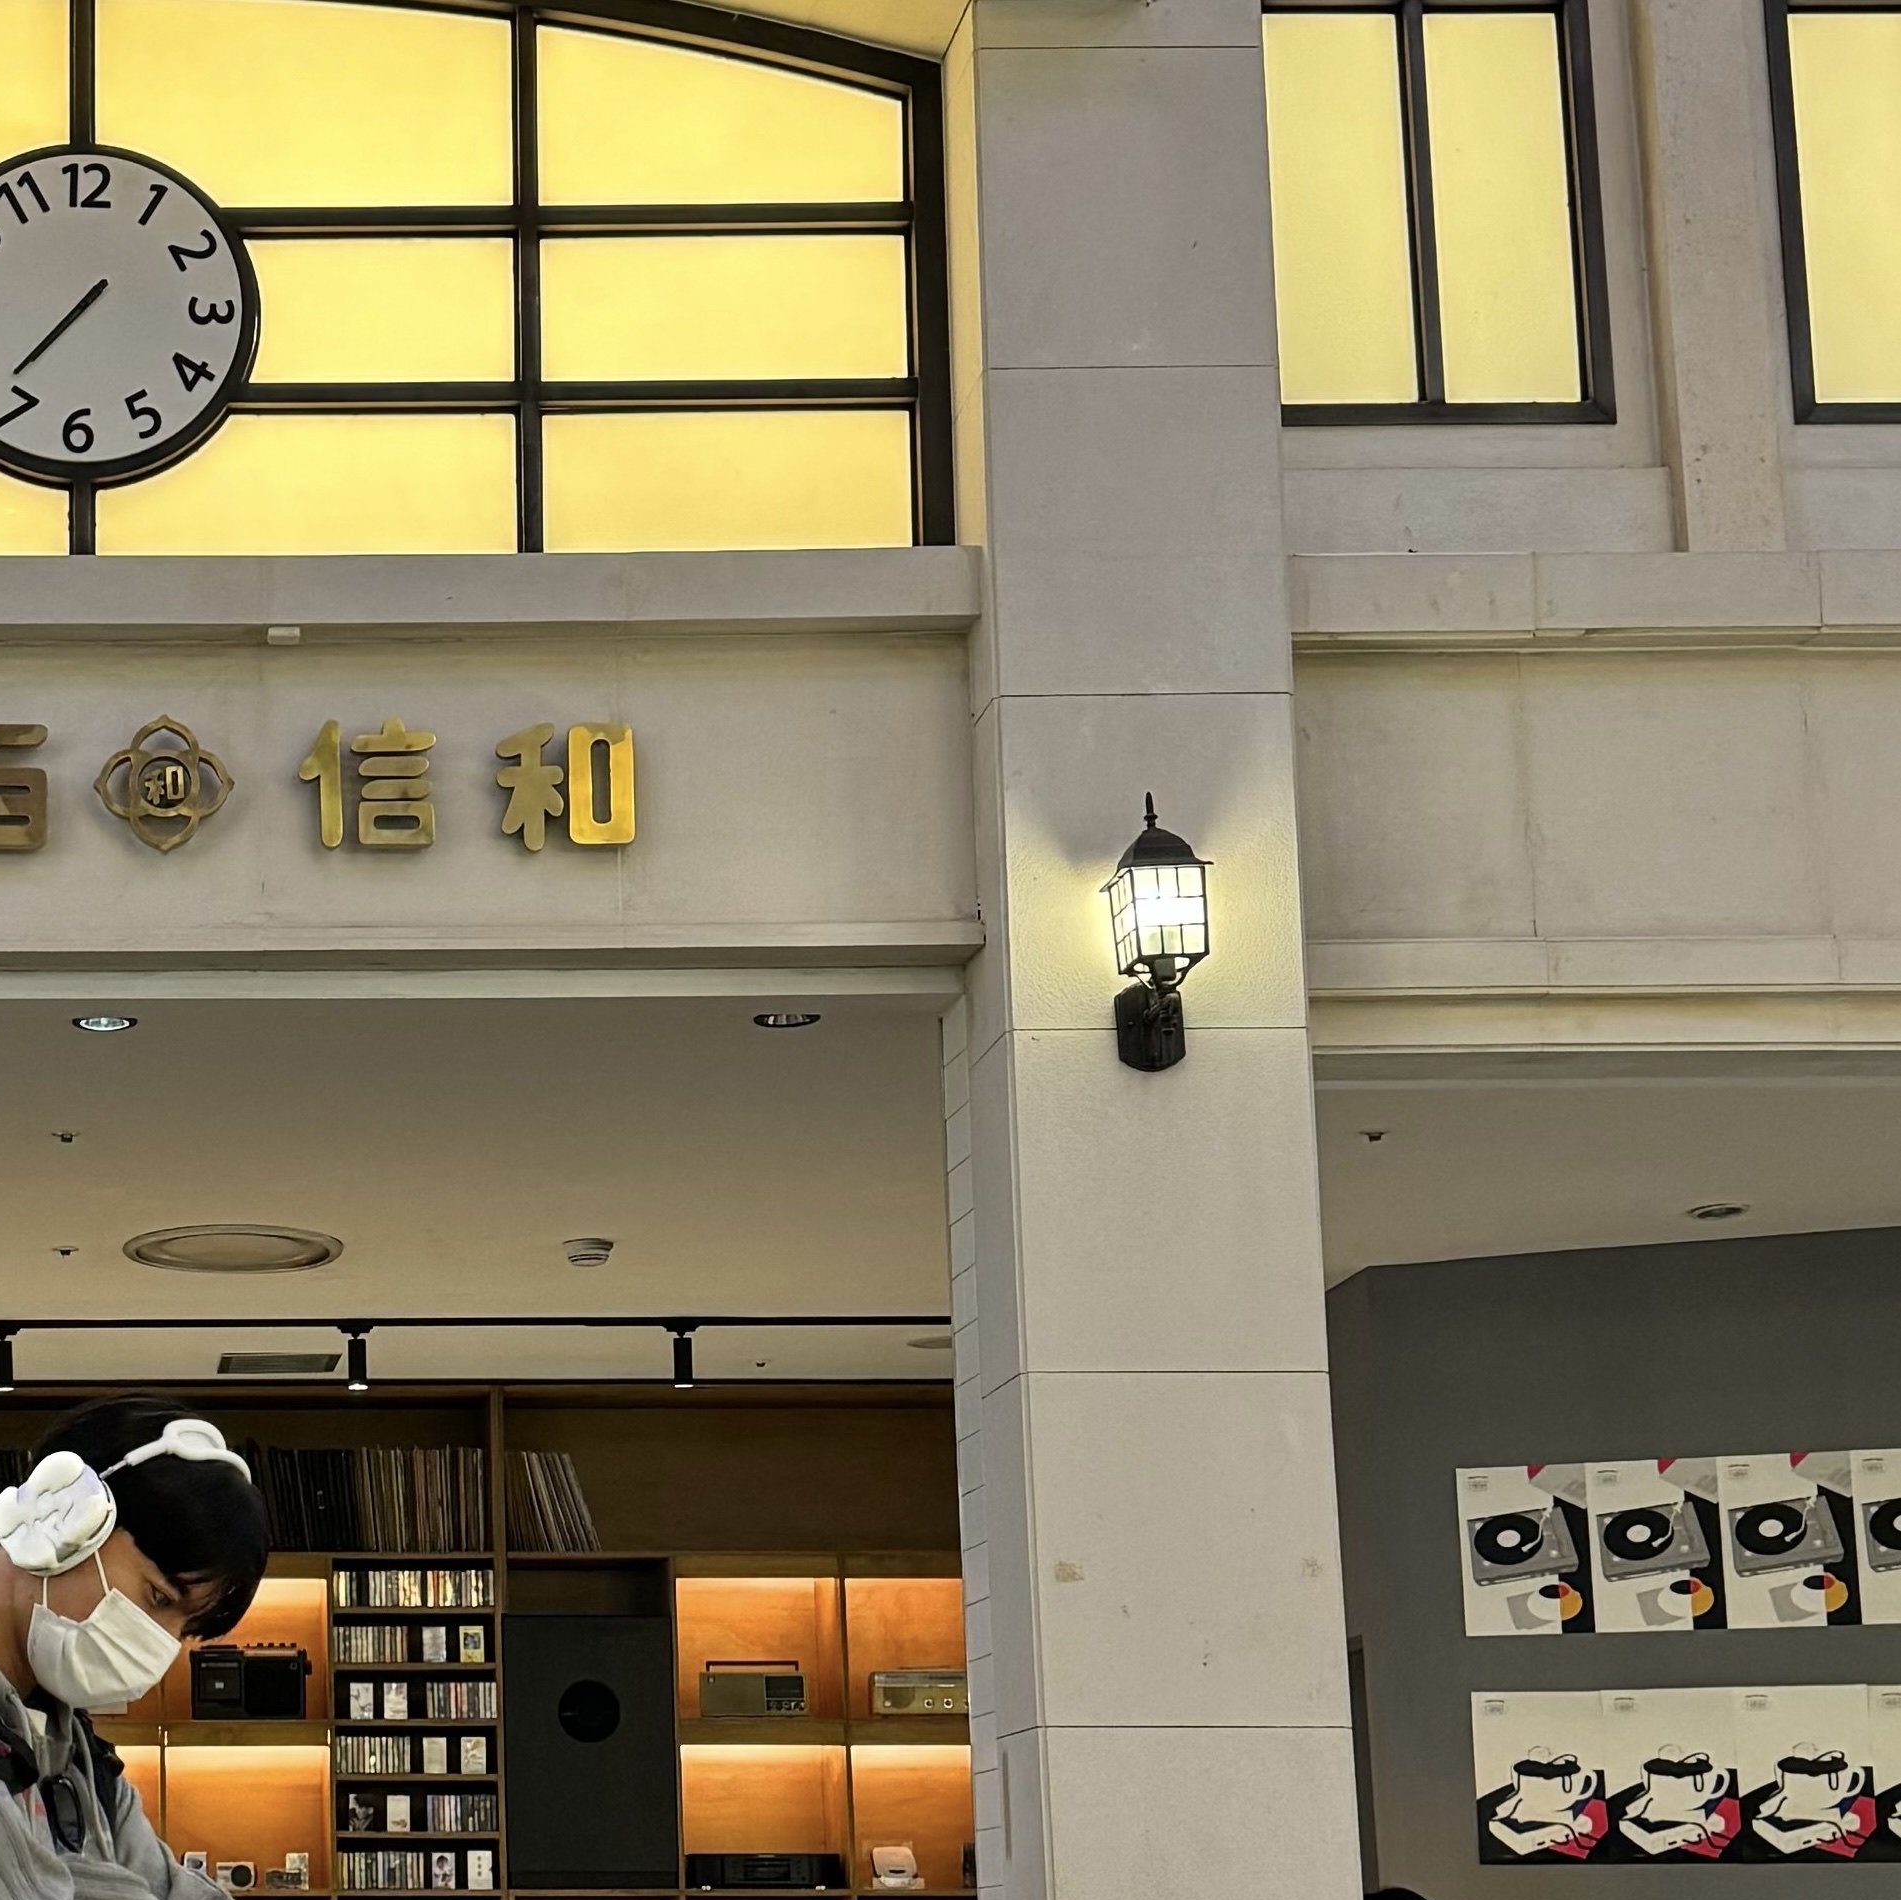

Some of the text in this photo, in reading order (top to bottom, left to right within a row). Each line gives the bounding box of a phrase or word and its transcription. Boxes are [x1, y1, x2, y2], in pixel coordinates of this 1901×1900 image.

[61, 163, 112, 209] 12
[138, 184, 168, 226] 1
[167, 229, 217, 272] 2
[188, 296, 235, 325] 3
[172, 351, 216, 392] 4
[61, 408, 94, 453] 6
[124, 389, 162, 439] 5
